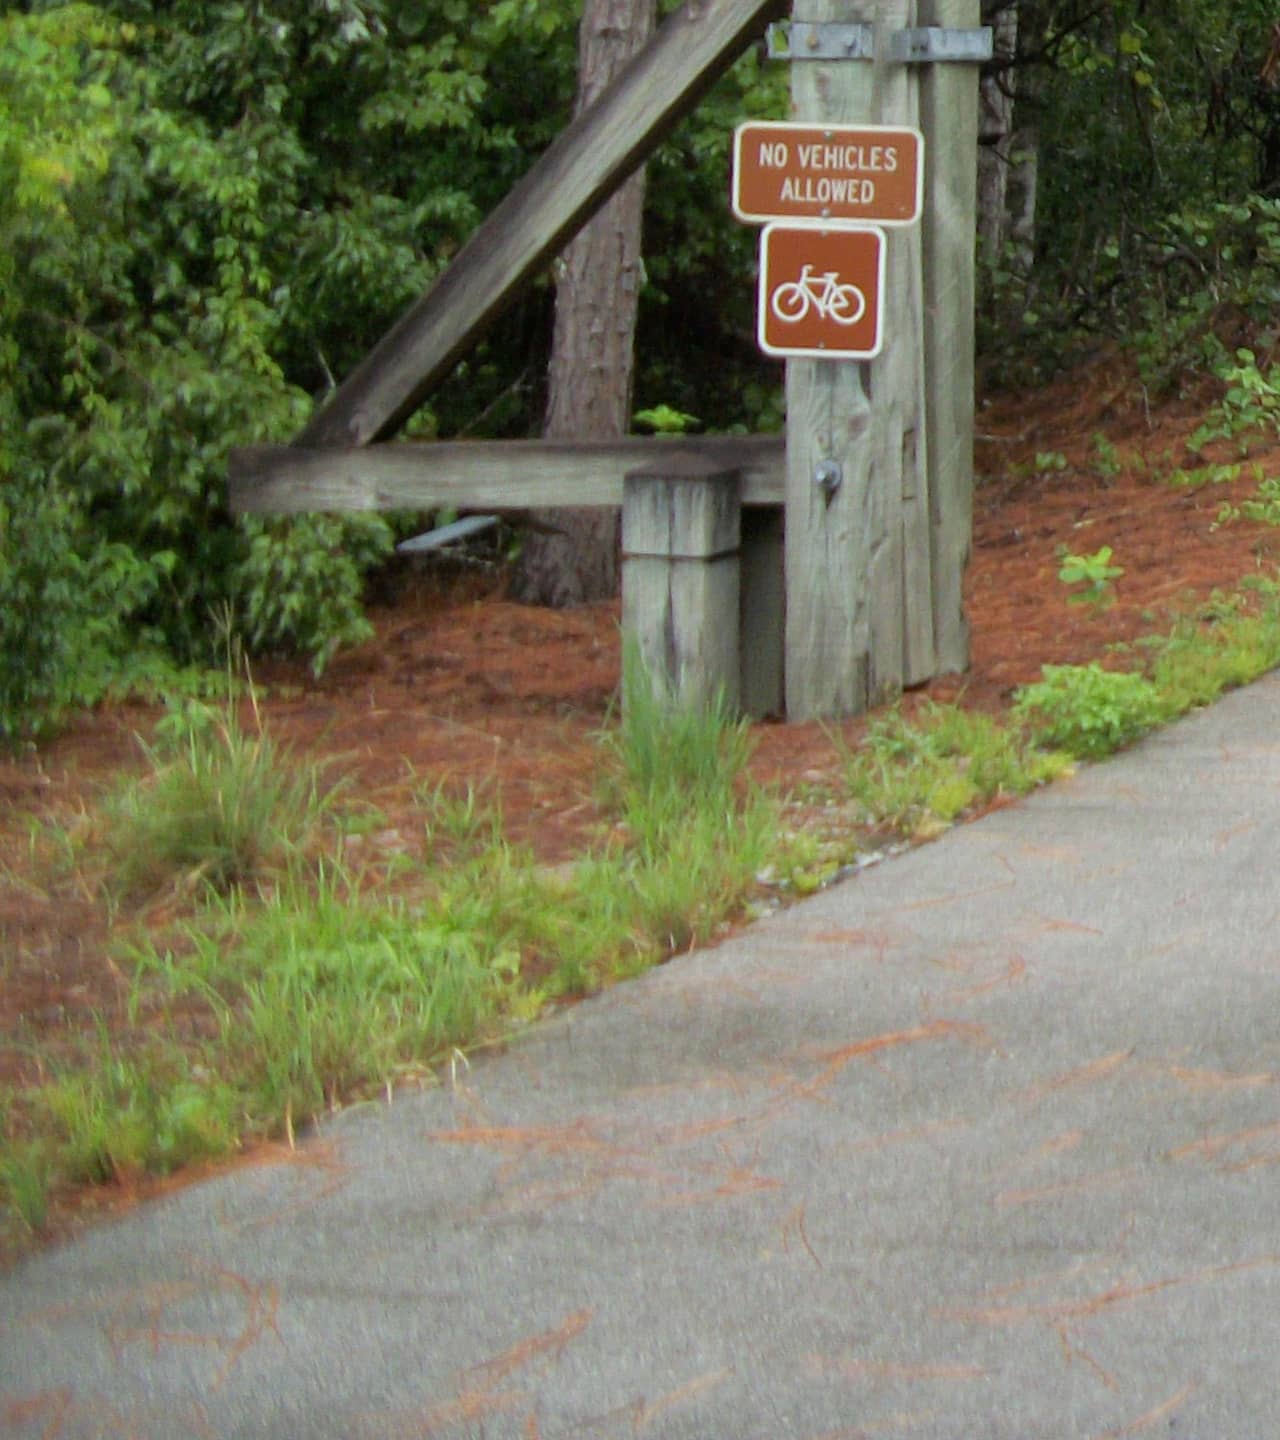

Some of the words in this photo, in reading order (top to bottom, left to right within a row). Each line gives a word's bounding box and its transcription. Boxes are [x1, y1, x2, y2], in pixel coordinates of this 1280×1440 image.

[759, 142, 788, 167] NO
[798, 144, 897, 171] VEHICLES
[780, 176, 875, 204] ALLOWED
